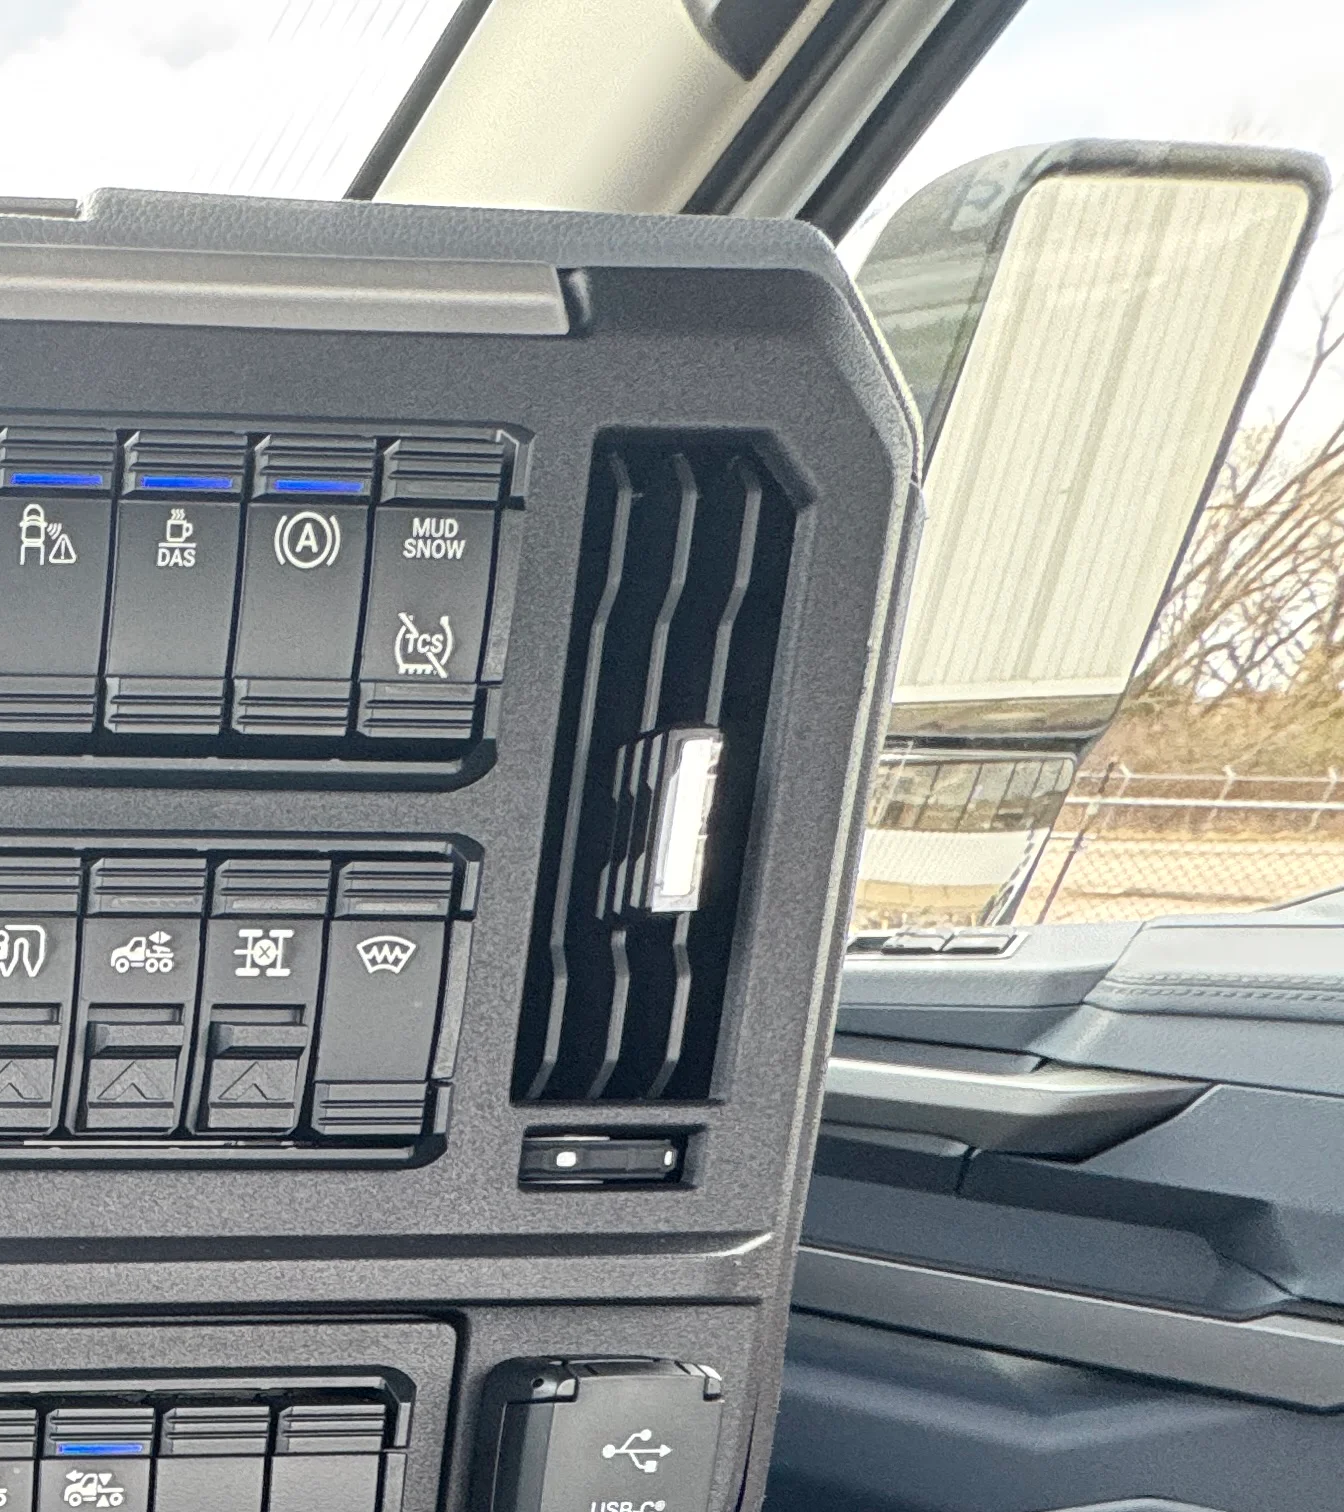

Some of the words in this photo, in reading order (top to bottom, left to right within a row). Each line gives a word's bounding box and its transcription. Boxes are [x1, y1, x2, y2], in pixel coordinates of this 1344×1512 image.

[412, 517, 459, 538] MUD
[157, 547, 196, 568] DAS
[403, 538, 466, 560] SNOW
[405, 633, 444, 654] TCS
